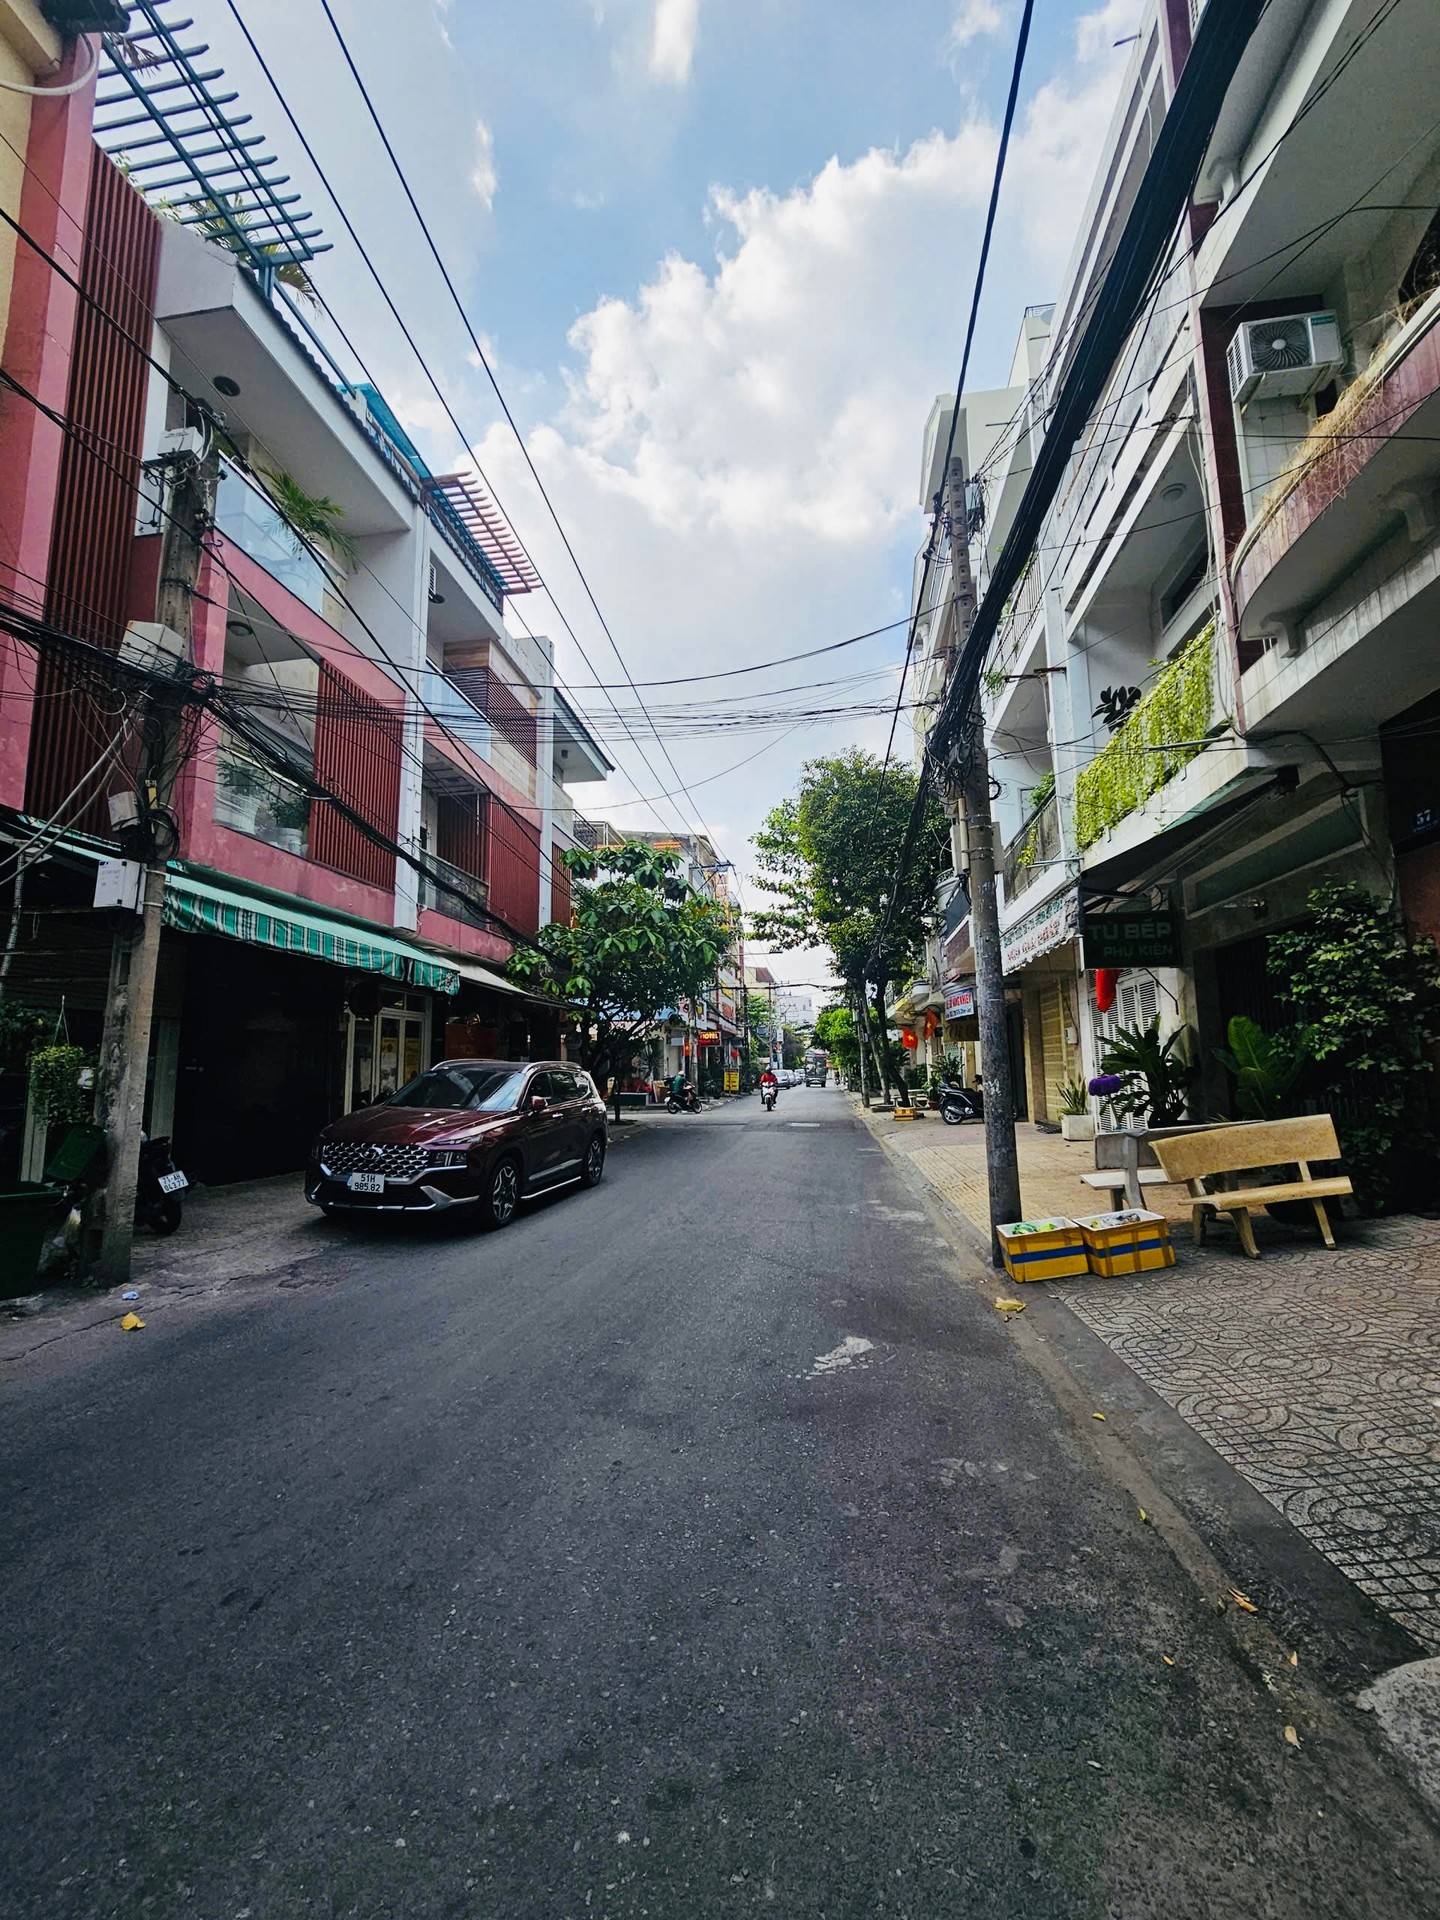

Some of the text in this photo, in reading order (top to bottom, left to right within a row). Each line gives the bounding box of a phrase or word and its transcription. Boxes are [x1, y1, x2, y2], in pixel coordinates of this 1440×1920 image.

[1416, 809, 1430, 825] 57
[1124, 917, 1171, 939] BẾP
[700, 1031, 718, 1039] HOTEL
[361, 1174, 376, 1182] 51H
